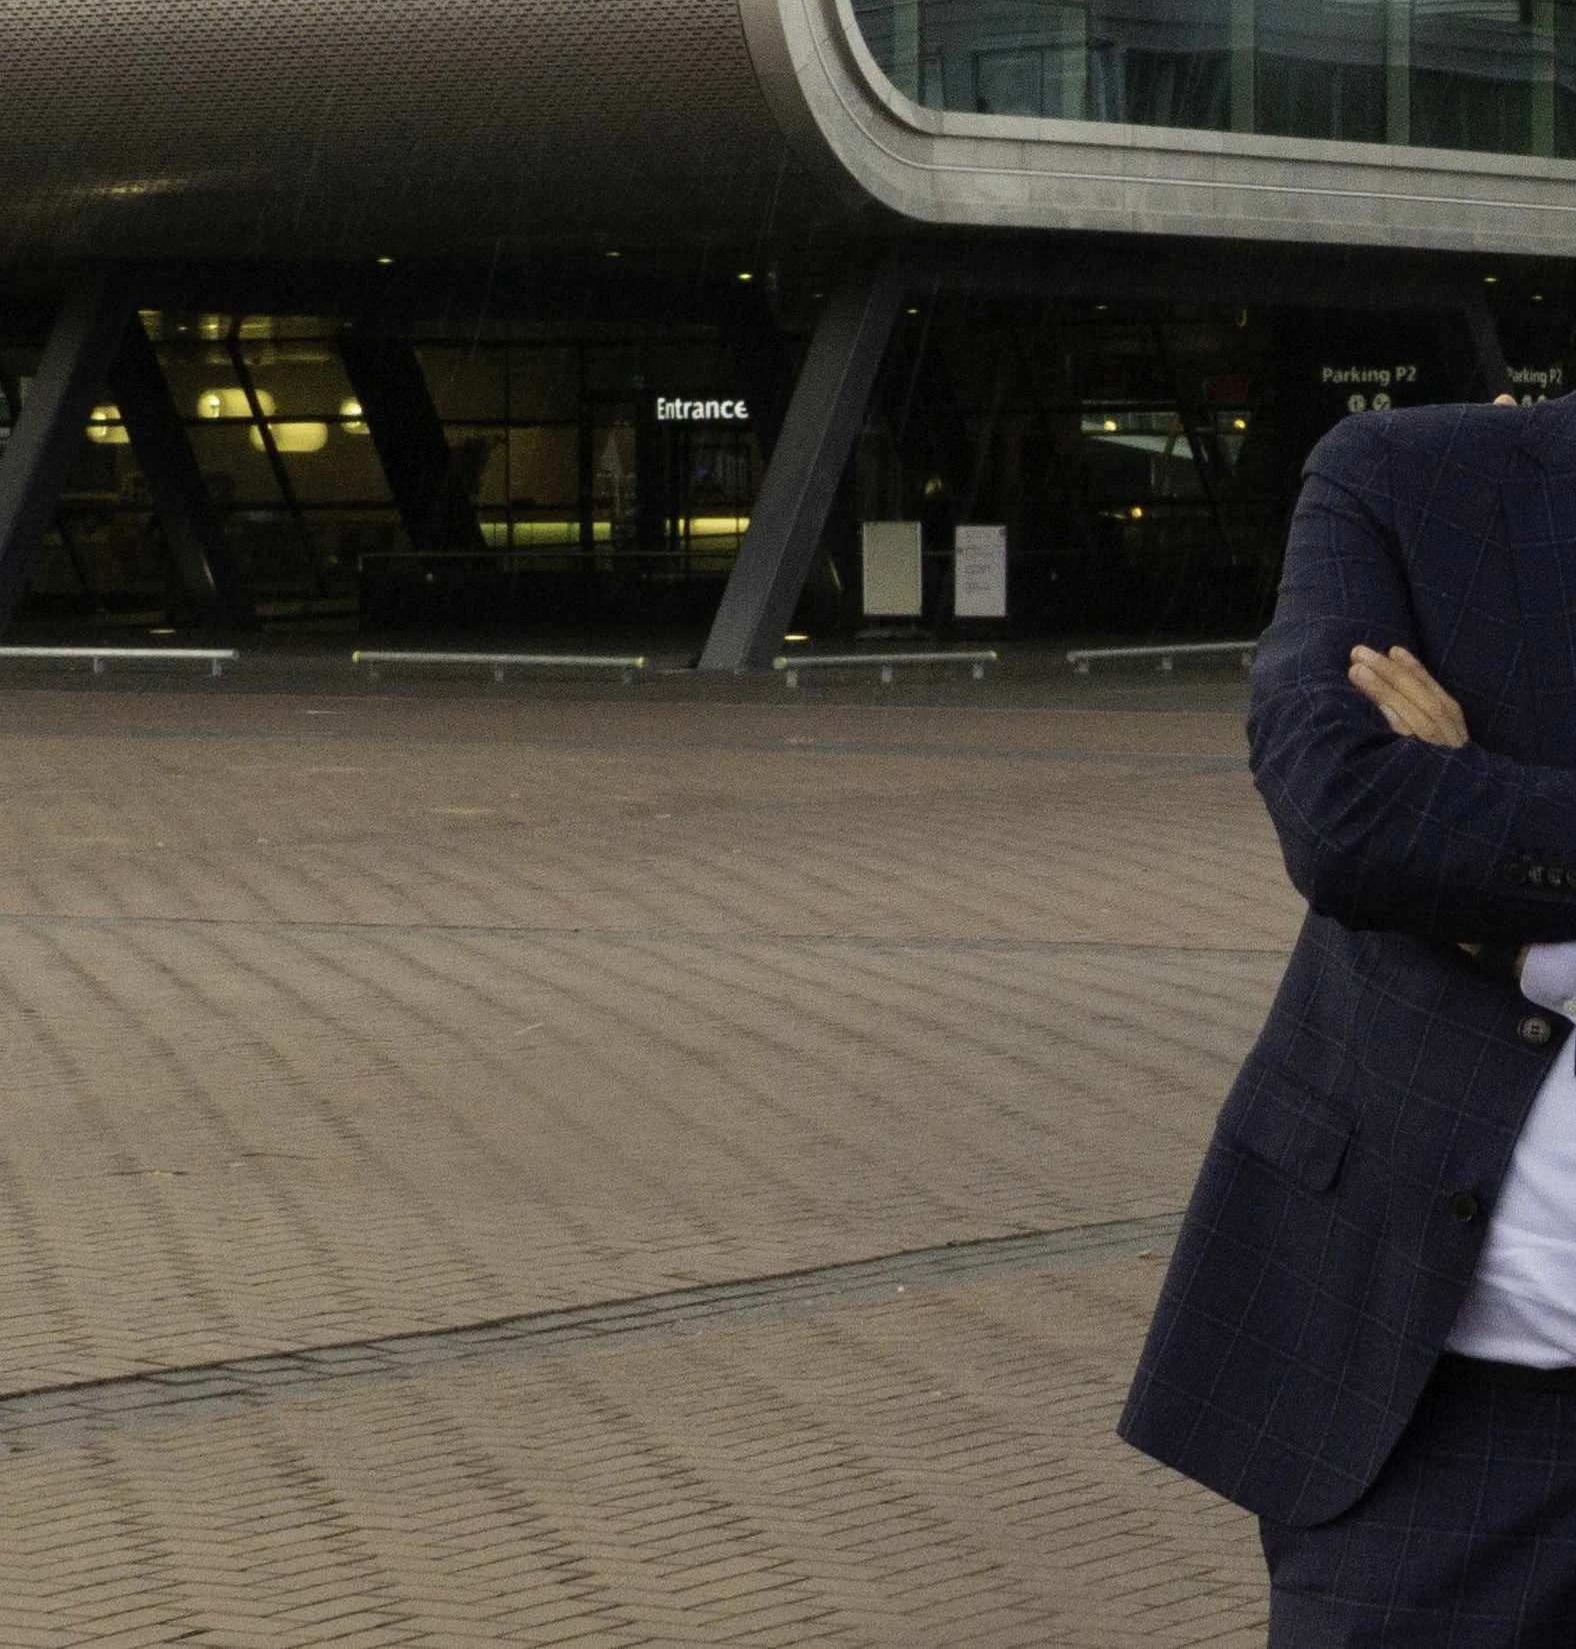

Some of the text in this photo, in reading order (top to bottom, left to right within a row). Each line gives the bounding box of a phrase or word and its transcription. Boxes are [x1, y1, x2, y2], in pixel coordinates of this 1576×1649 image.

[1321, 365, 1417, 387] Parking P2
[1548, 366, 1563, 384] P2
[656, 397, 749, 420] Entrance
